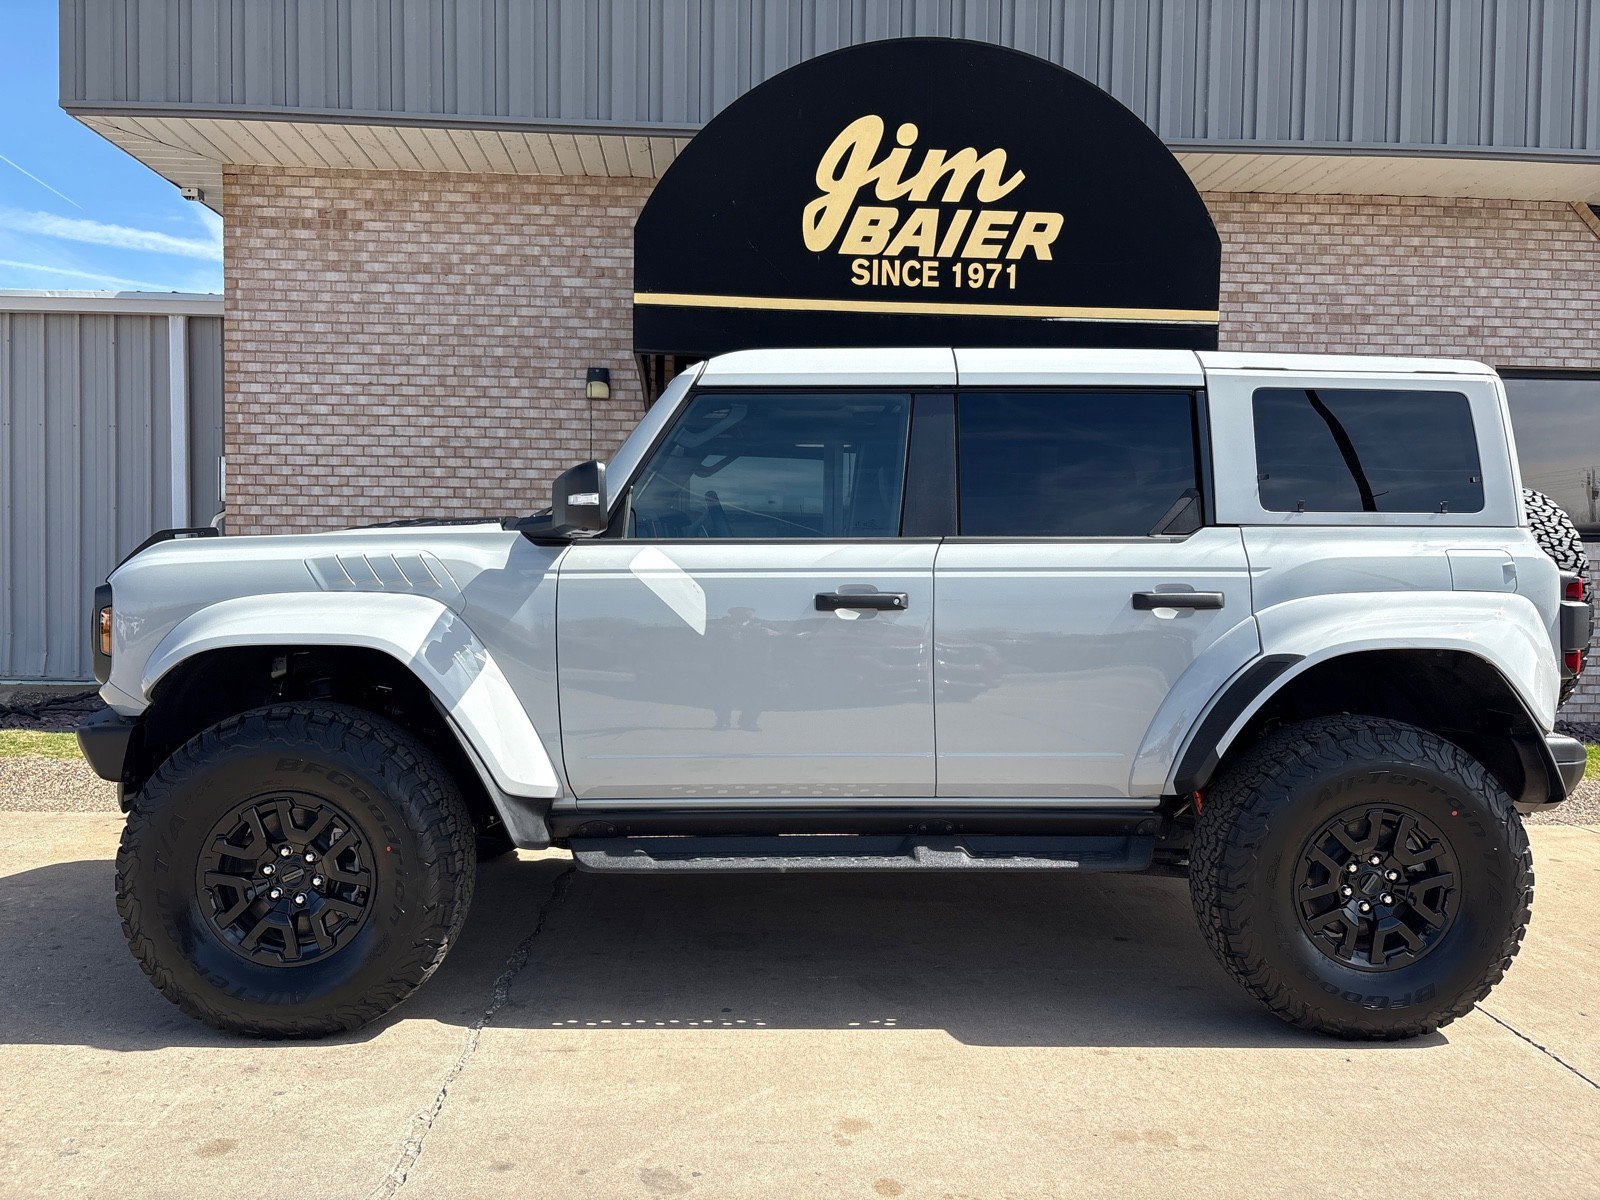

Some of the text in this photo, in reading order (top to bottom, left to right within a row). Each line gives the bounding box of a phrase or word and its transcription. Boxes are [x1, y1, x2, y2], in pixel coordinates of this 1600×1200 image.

[802, 114, 1026, 253] Jim
[838, 206, 1065, 261] BAIER
[850, 258, 1017, 290] SINCE 1971
